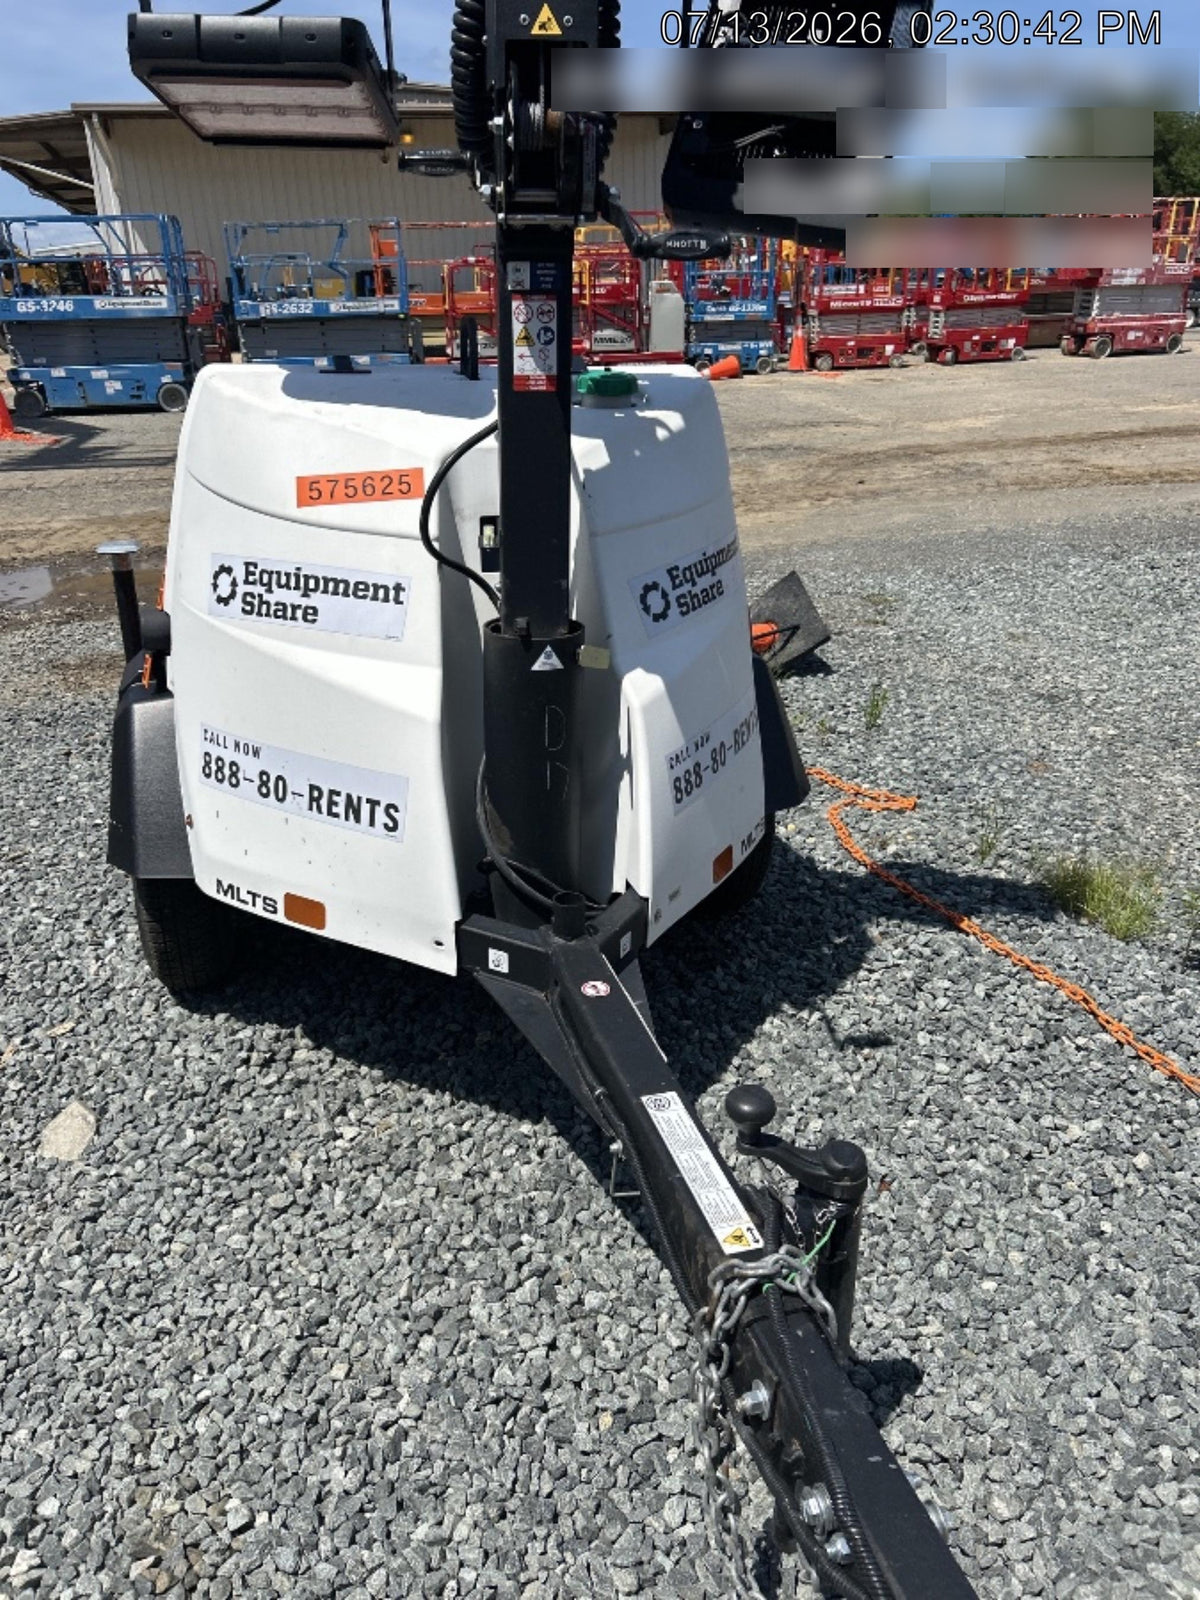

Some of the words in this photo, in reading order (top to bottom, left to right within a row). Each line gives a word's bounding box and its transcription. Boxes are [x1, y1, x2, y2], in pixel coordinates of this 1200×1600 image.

[308, 474, 412, 500] 575625
[243, 562, 406, 605] Equipment
[675, 579, 724, 617] Share
[241, 592, 319, 624] Share
[203, 728, 228, 750] CALL
[234, 739, 262, 760] NOW
[669, 746, 690, 770] CALL
[202, 752, 400, 833] 888-80-RENTS
[216, 878, 278, 915] MLTS
